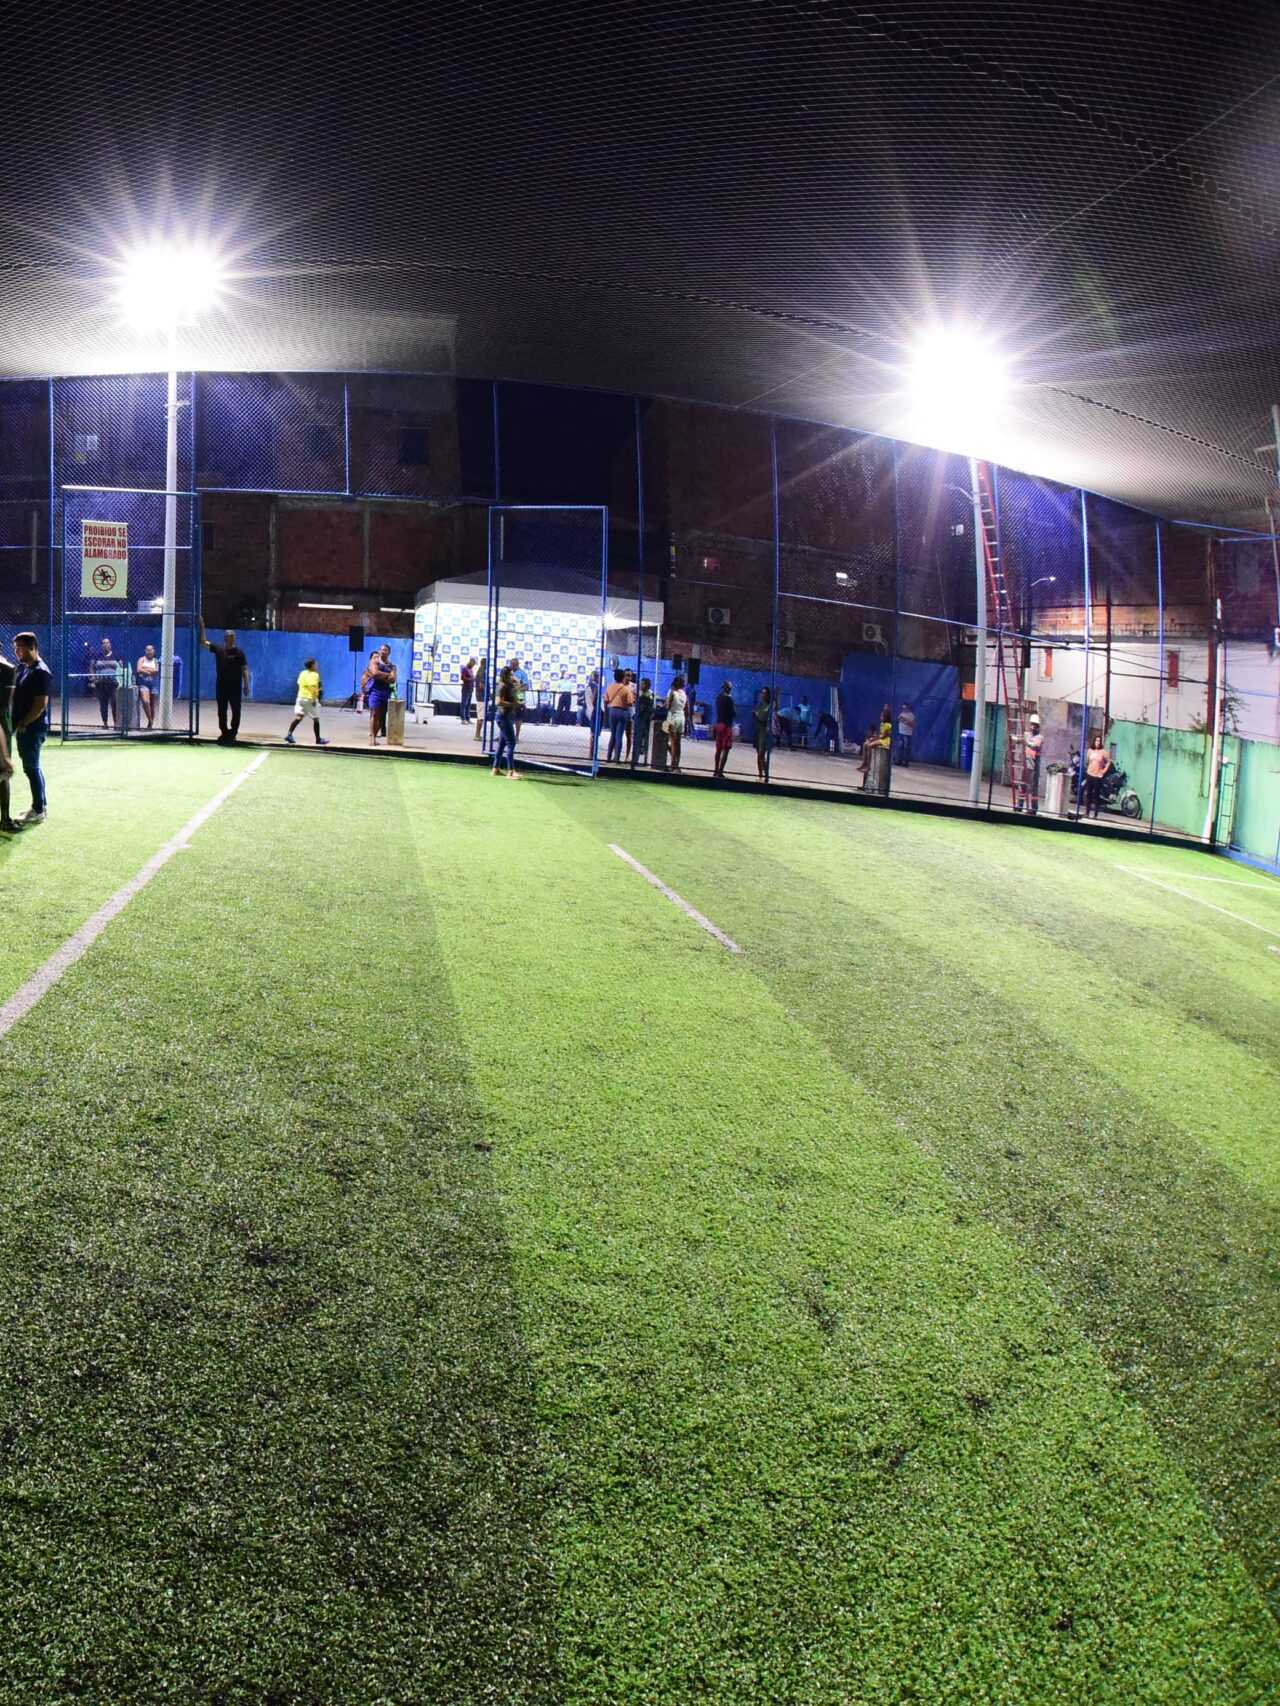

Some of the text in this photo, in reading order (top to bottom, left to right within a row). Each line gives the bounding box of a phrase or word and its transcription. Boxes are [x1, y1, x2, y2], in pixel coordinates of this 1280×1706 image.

[84, 525, 126, 536] PROIBIDO SE
[84, 536, 126, 548] ESCORAR NO
